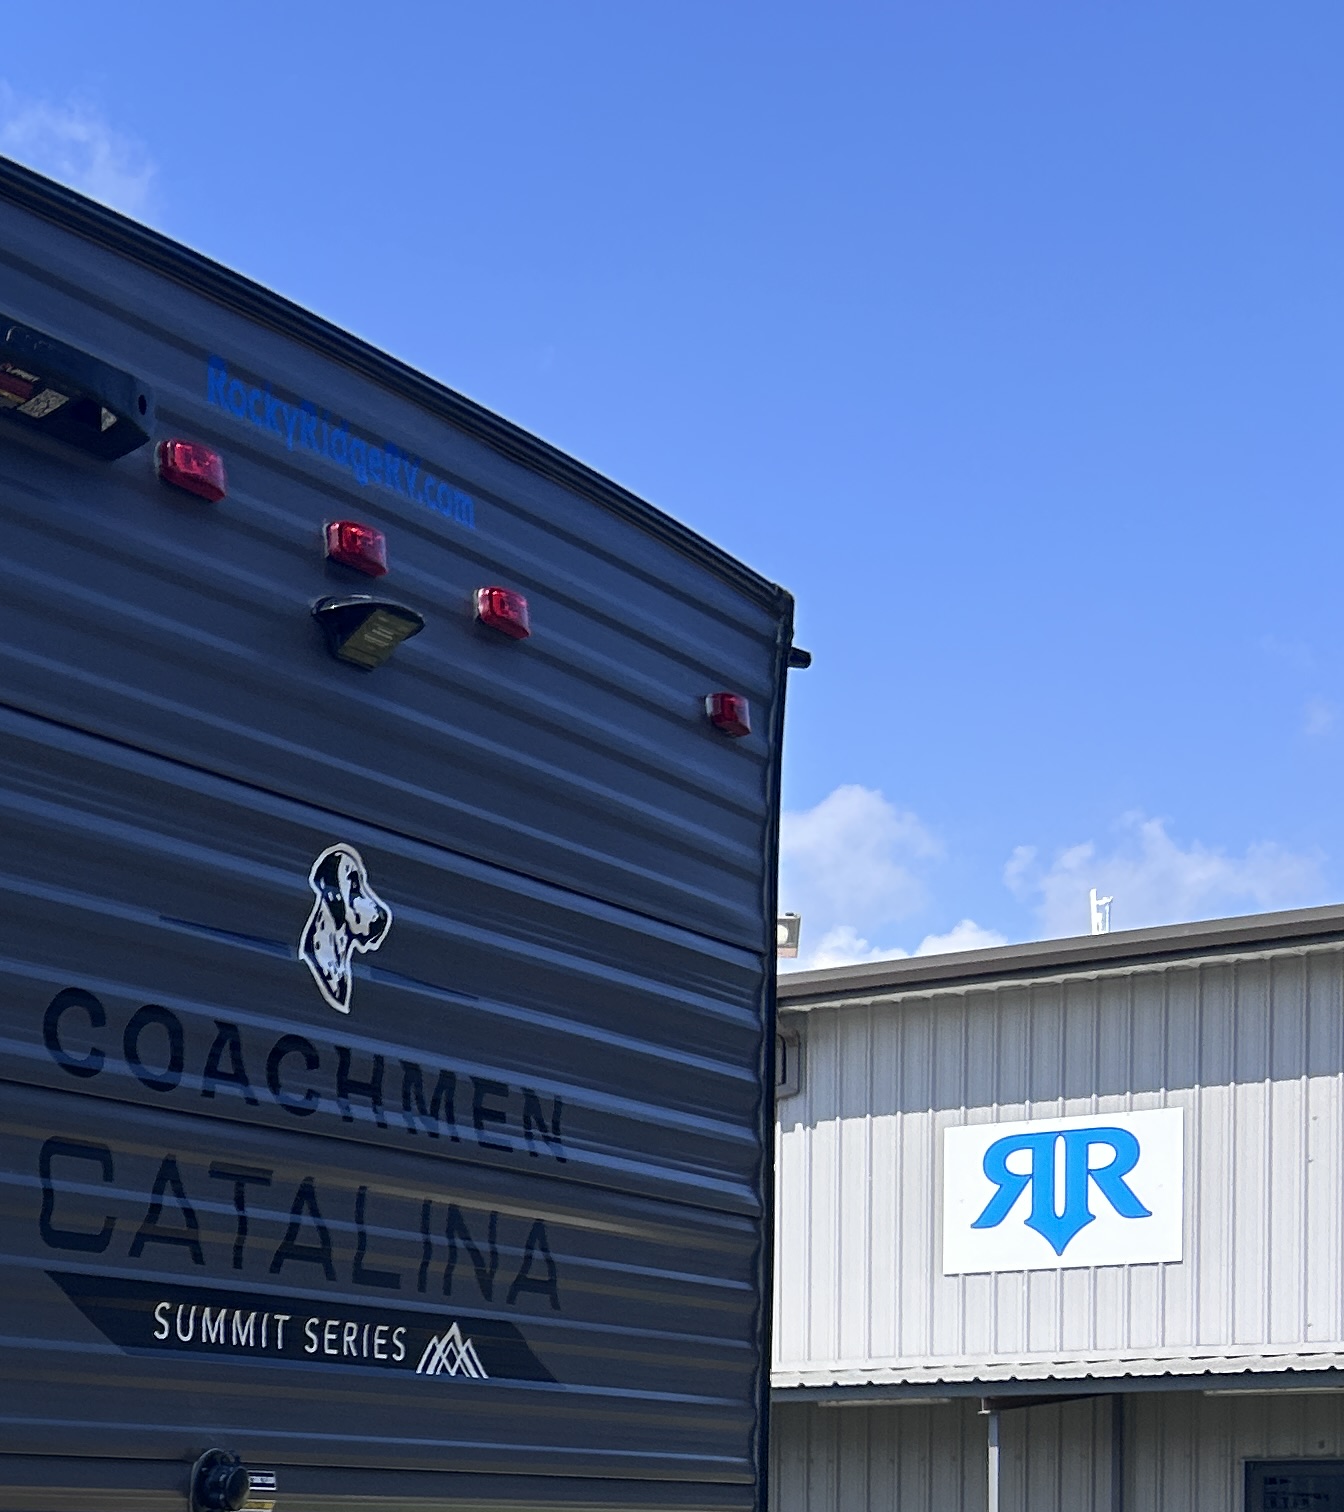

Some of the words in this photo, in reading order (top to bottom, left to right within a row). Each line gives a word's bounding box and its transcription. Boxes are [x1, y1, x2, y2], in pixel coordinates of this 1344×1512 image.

[43, 987, 567, 1163] COACHMEN
[39, 1135, 562, 1311] CATALINA
[153, 1301, 290, 1350] SUMMIT
[304, 1316, 408, 1362] SERIES
